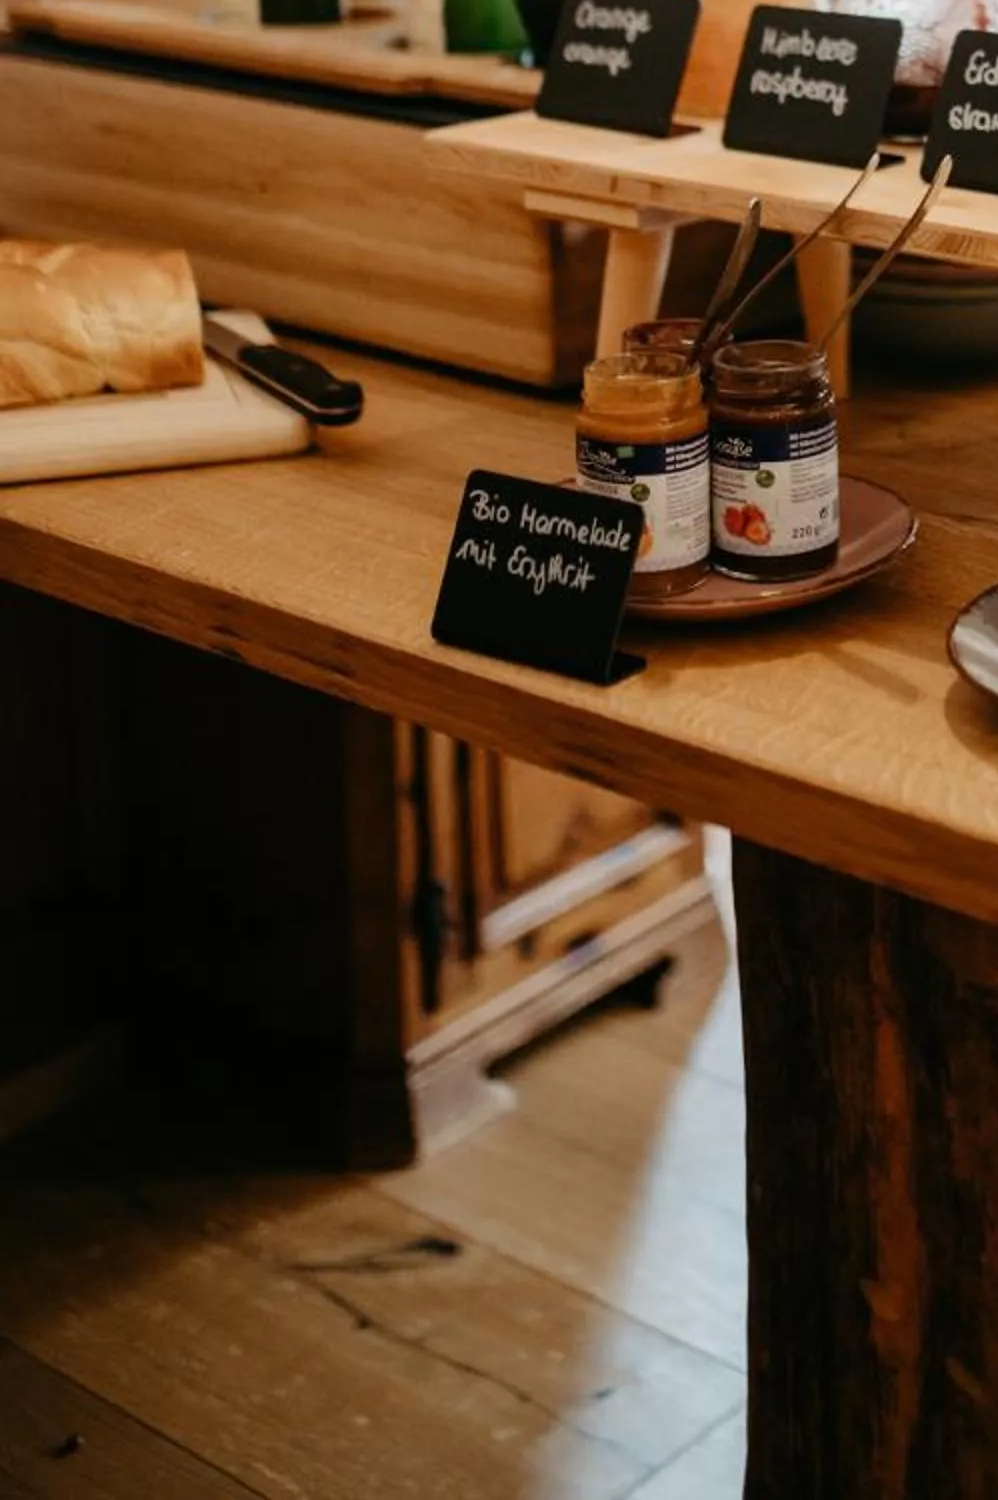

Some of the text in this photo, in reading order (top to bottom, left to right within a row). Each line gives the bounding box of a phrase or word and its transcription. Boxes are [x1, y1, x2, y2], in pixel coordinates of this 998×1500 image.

[468, 489, 632, 553] Bio Marmelade
[455, 538, 498, 571] mit
